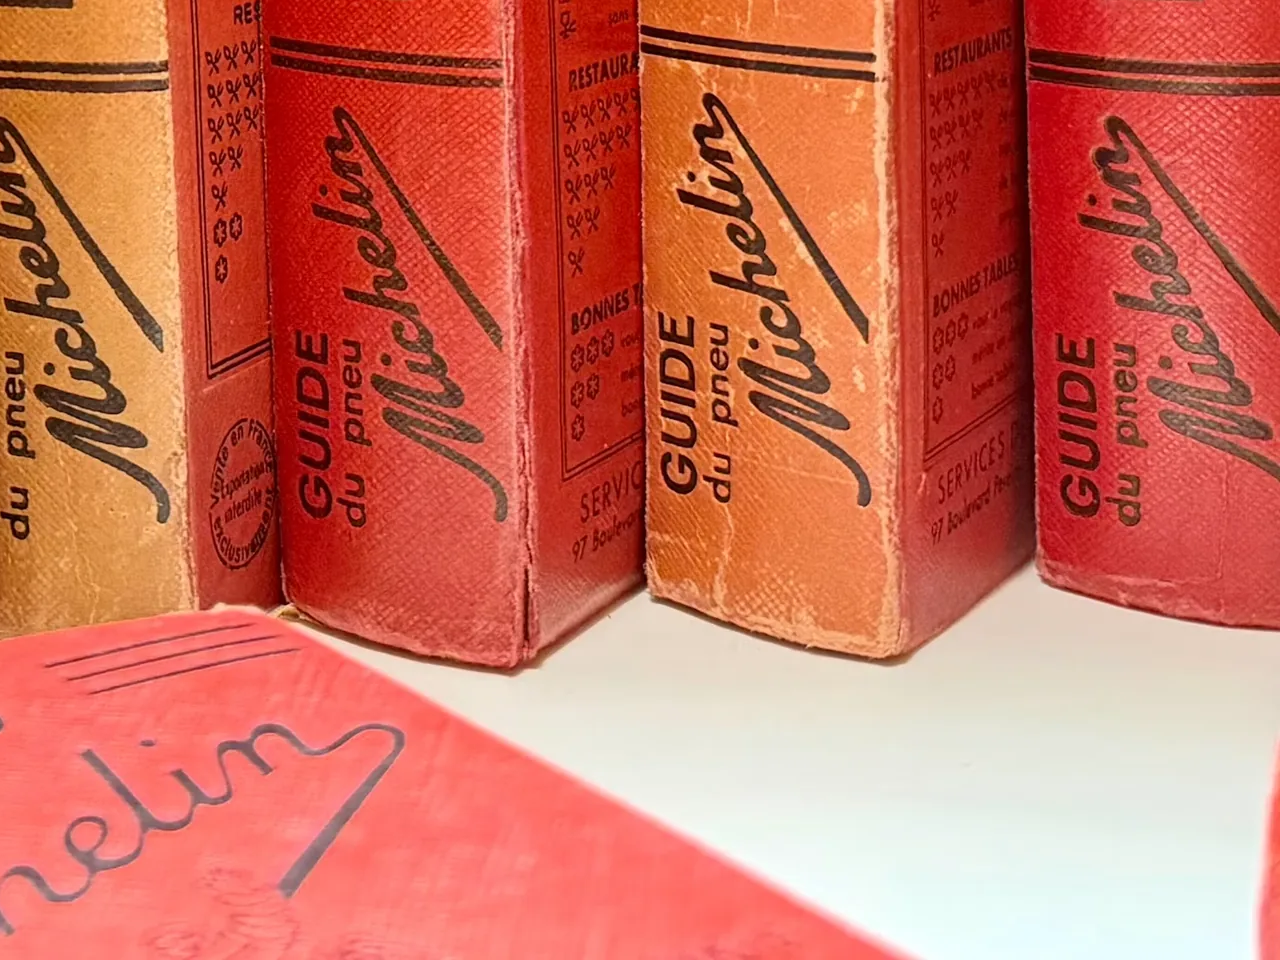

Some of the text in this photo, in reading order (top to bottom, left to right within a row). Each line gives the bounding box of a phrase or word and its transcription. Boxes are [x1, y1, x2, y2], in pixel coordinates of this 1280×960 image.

[934, 25, 1013, 77] RESTAURANTS
[311, 105, 508, 523] Michelin
[571, 288, 630, 336] BONNES
[675, 91, 870, 508] Michelin
[932, 268, 981, 319] BONNES
[1076, 114, 1280, 480] Michelin
[4, 350, 37, 460] pneu
[230, 423, 245, 448] en
[296, 330, 333, 520] GUIDE
[336, 340, 374, 529] du pneu
[658, 312, 697, 496] GUIDE
[701, 322, 738, 504] du pneu
[937, 430, 1005, 505] SERVICES
[1056, 333, 1104, 518] GUIDE
[1104, 343, 1142, 526] du pneu
[572, 534, 588, 564] 97
[931, 516, 944, 546] 97
